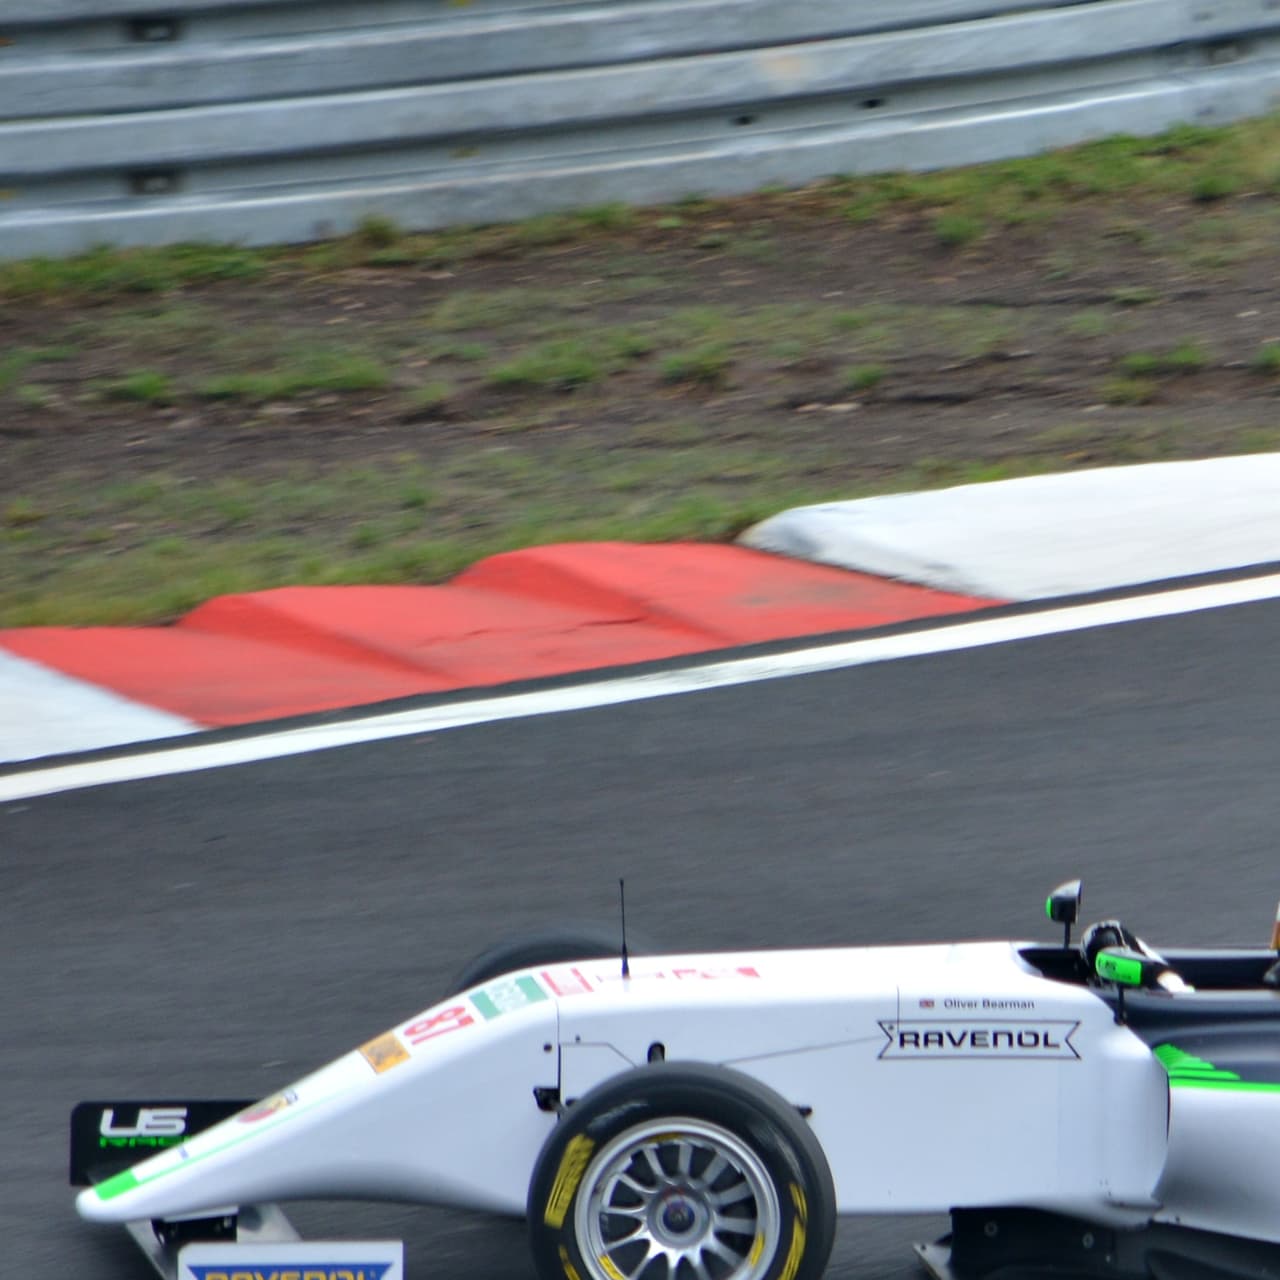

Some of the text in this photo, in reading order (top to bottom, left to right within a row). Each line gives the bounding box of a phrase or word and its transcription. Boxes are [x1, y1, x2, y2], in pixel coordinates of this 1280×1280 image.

[944, 998, 1034, 1010] Oliver Bearman
[899, 1030, 1061, 1049] RAVENOL
